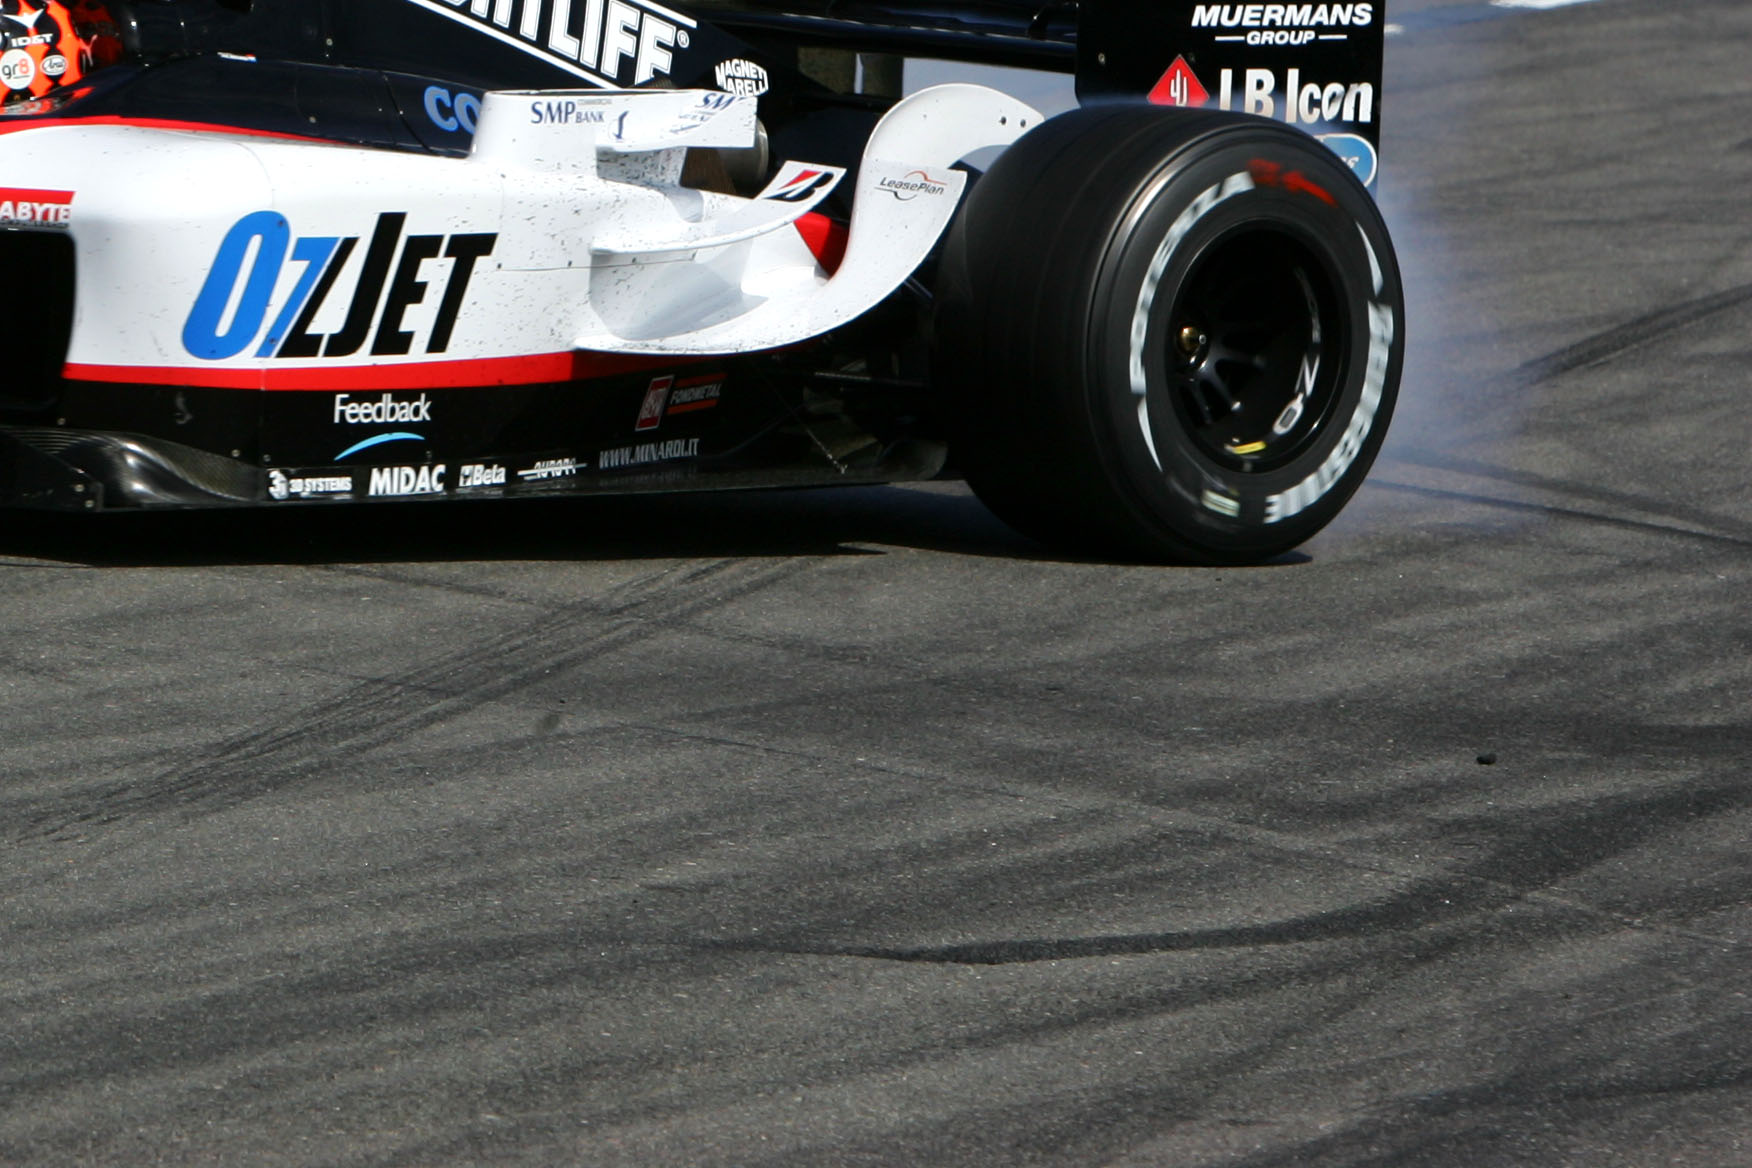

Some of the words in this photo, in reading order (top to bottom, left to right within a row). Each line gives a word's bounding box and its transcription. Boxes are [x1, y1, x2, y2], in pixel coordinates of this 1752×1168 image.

[1192, 3, 1372, 27] MUERMANS
[1247, 30, 1315, 45] GROUP
[2, 58, 30, 78] gr8
[1286, 68, 1373, 124] Icon
[530, 101, 576, 124] SMP
[576, 110, 605, 124] BANK
[879, 176, 945, 195] LeasePlan
[333, 393, 431, 423] Feedback
[599, 438, 700, 469] WWW.MINARDI.IT
[368, 465, 446, 496] MIDAC
